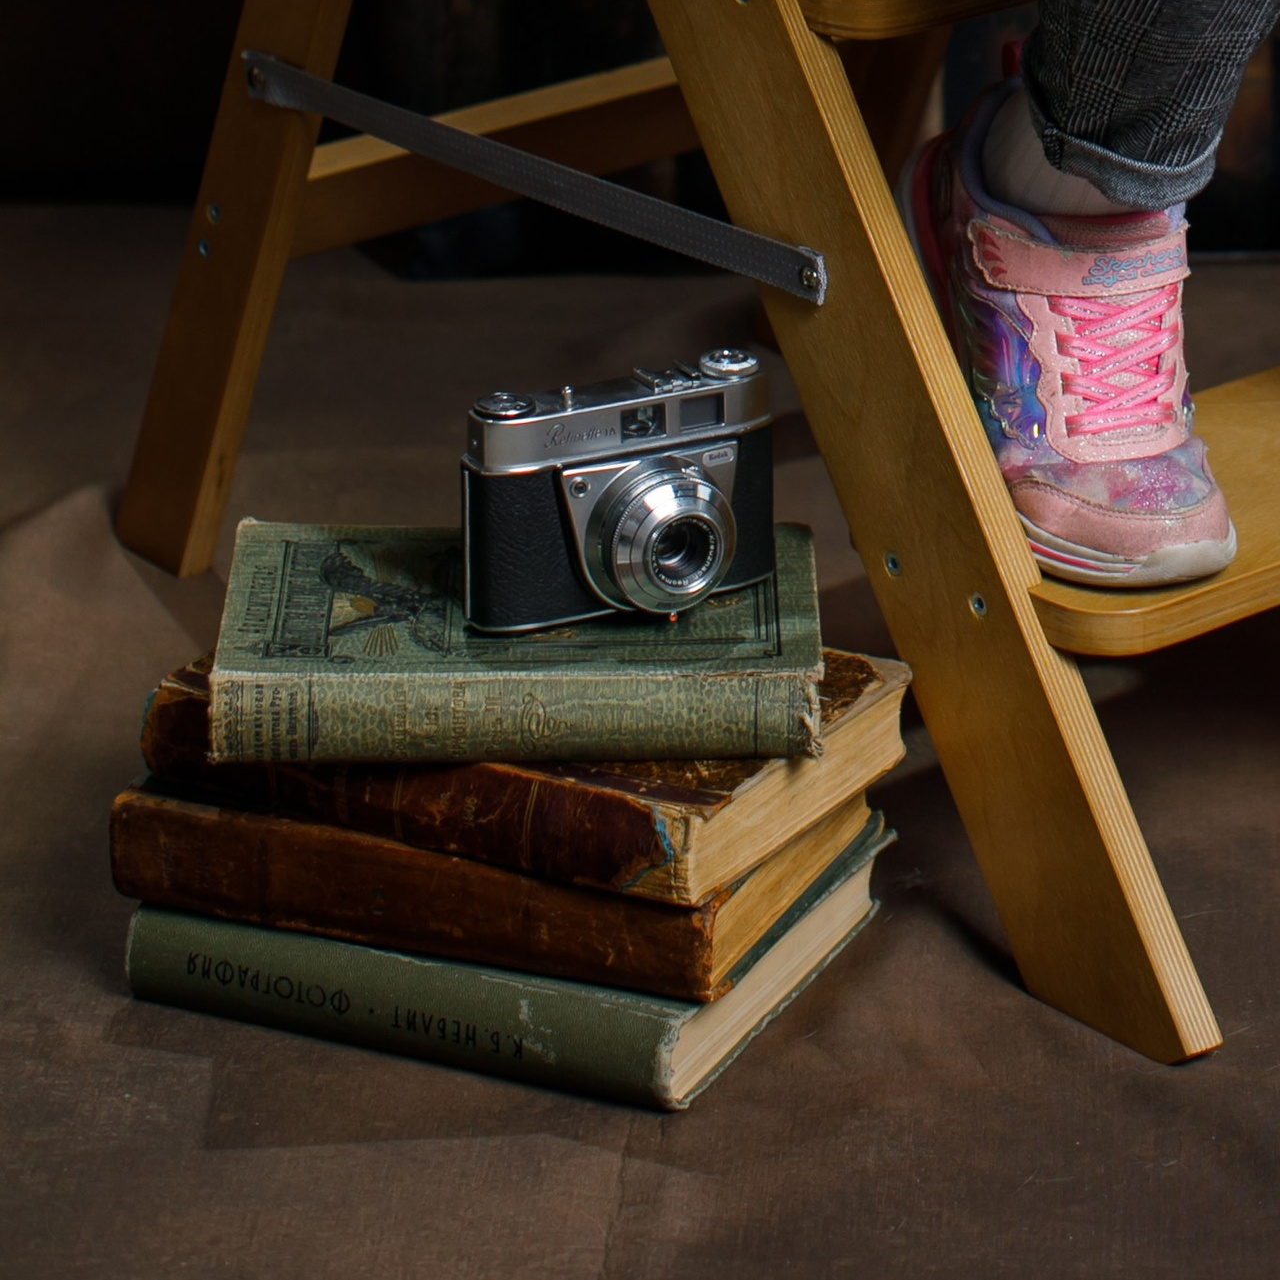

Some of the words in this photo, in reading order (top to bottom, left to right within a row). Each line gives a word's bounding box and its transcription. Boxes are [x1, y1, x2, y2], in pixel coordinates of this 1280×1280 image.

[1088, 244, 1184, 276] Skechers
[707, 449, 730, 461] Kodak
[186, 951, 351, 1017] ФОТОГРАФИЯ
